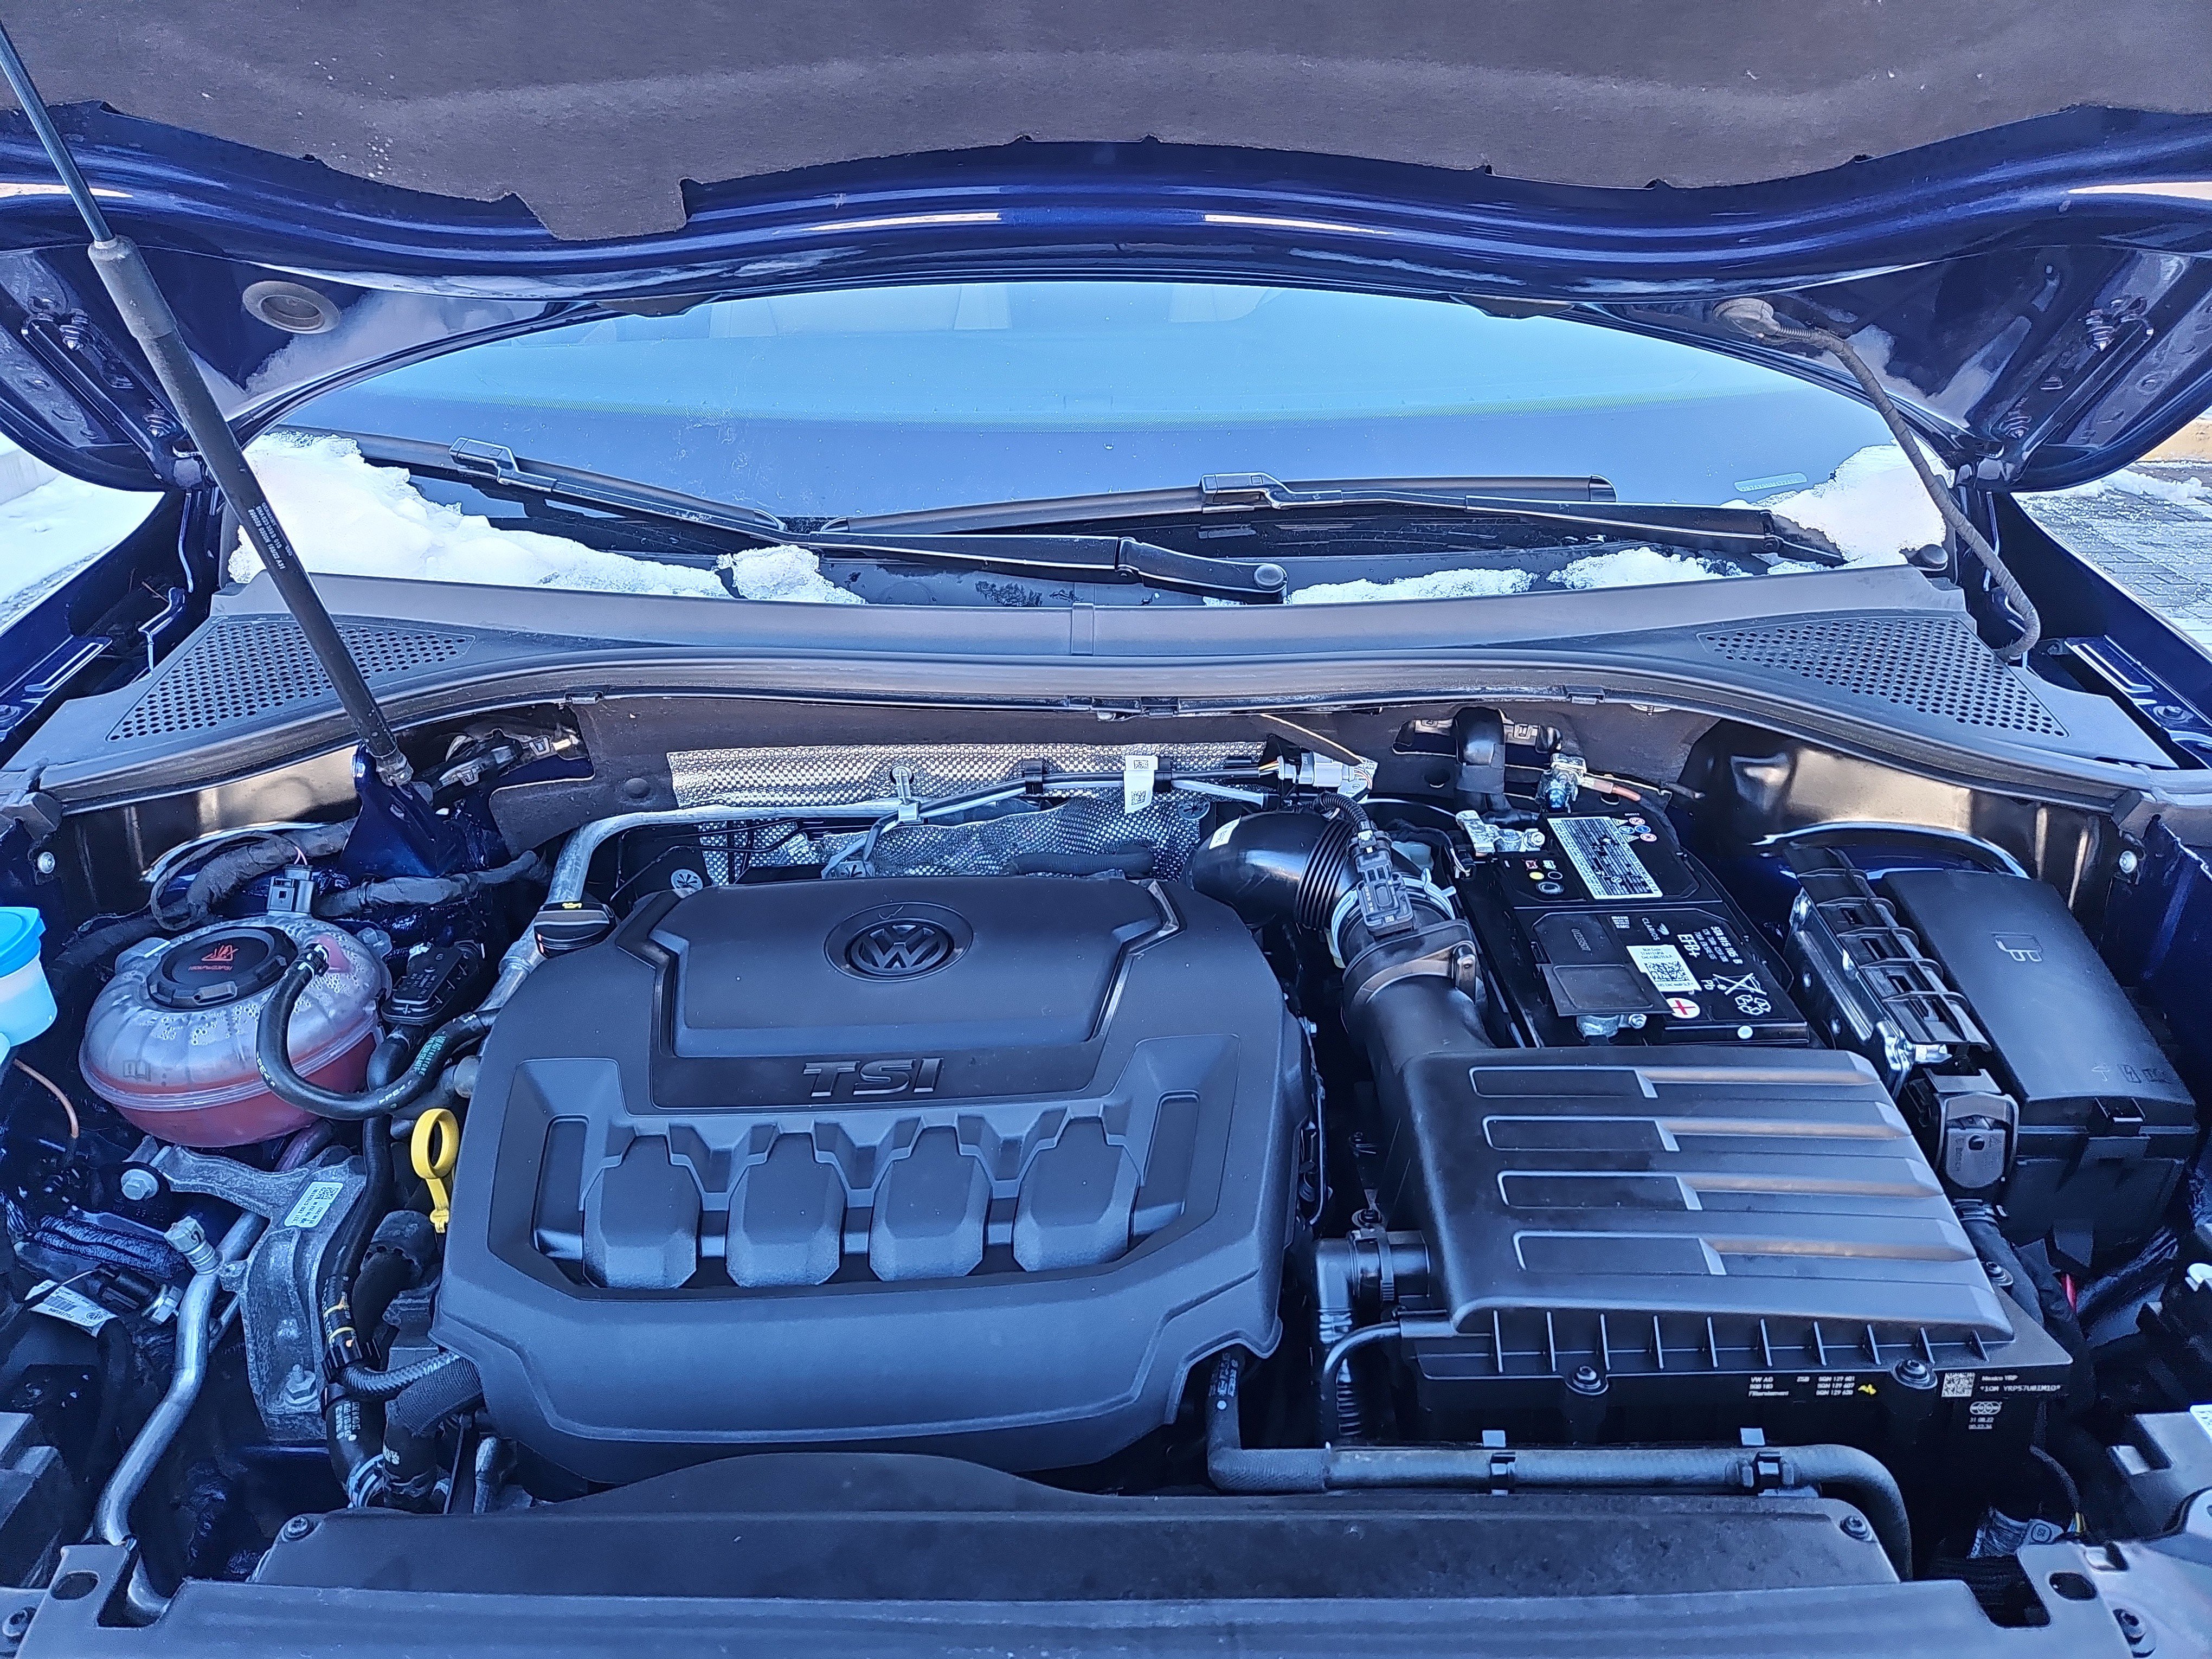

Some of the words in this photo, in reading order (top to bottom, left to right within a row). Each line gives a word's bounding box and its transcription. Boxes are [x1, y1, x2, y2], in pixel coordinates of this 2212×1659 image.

[261, 501, 276, 526] GERMANY
[1642, 917, 1661, 941] CLARIOS
[849, 922, 949, 976] VW
[1677, 934, 1701, 958] EFB+
[1717, 936, 1732, 947] 915
[1701, 979, 1716, 991] Pb
[803, 1057, 944, 1097] TSI
